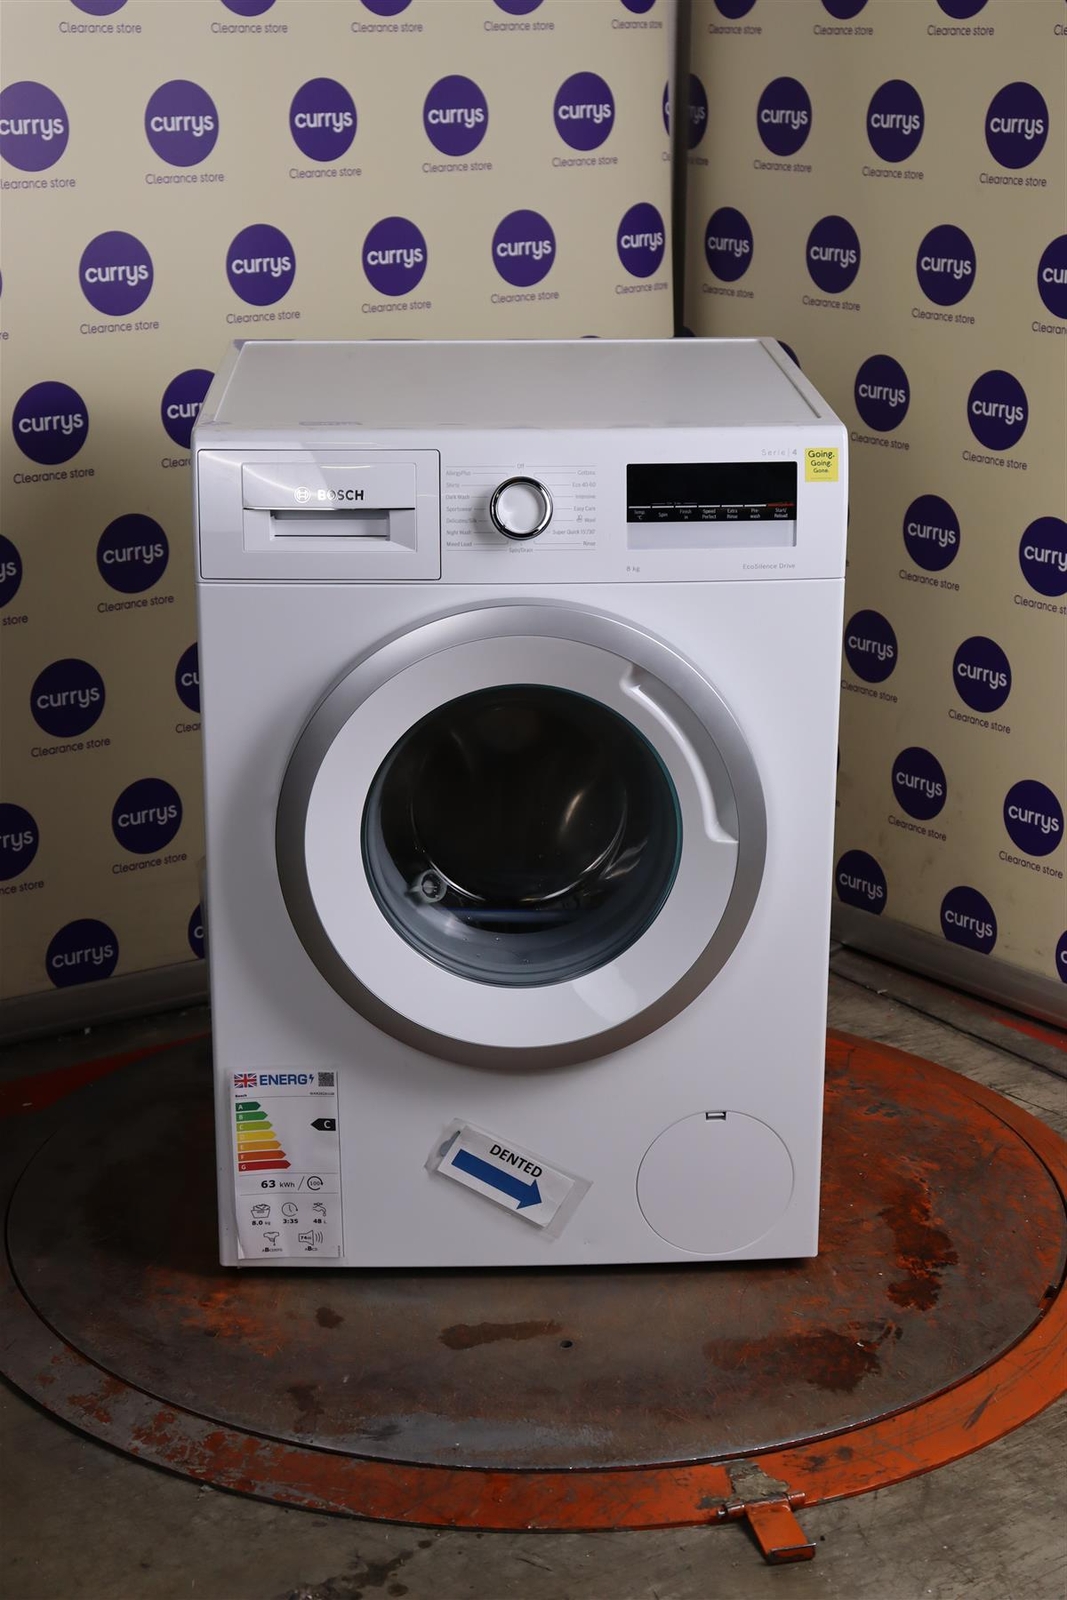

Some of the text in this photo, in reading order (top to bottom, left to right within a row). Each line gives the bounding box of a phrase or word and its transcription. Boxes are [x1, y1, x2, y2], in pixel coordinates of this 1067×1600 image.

[59, 22, 141, 33] Clearance store
[211, 22, 288, 33] Clearance store
[351, 22, 423, 33] Clearance store
[484, 21, 554, 31] Clearance store
[612, 19, 648, 29] Clearance
[708, 24, 762, 35] Clearance store
[814, 25, 873, 35] Clearance store
[927, 25, 994, 35] Clearance store
[295, 112, 353, 132] currys
[428, 108, 484, 128] currys
[558, 104, 611, 123] currys
[761, 109, 808, 129] currys
[0, 119, 64, 140] currys
[151, 116, 214, 137] currys
[871, 114, 920, 135] currys
[990, 118, 1043, 140] currys
[422, 163, 492, 173] Clearance store
[552, 157, 618, 167] Clearance store
[754, 160, 812, 173] Clearance store
[145, 174, 224, 184] Clearance store
[289, 168, 362, 179] Clearance store
[862, 166, 924, 180] Clearance store
[979, 173, 1047, 187] Clearance store
[0, 178, 76, 190] learance store
[497, 240, 551, 260] currys
[621, 233, 665, 252] currys
[708, 237, 749, 257] currys
[367, 248, 423, 268] currys
[810, 246, 856, 268] currys
[85, 265, 148, 286] currys
[232, 257, 291, 277] currys
[921, 257, 971, 279] currys
[491, 292, 559, 304] Clearance store
[615, 284, 652, 295] Clearance
[702, 284, 754, 299] Clearance store
[362, 301, 431, 313] Clearance store
[802, 296, 861, 312] Clearance store
[226, 311, 300, 324] Clearance store
[911, 308, 976, 325] Clearance store
[80, 322, 159, 334] Clearance store
[1032, 321, 1067, 335] Clearan
[859, 384, 905, 407] currys
[167, 403, 201, 421] cur
[972, 401, 1023, 425] currys
[19, 414, 83, 434] currys
[850, 432, 910, 451] Clearance store
[761, 448, 786, 456] Serie
[808, 450, 835, 459] Going.
[962, 450, 1028, 471] Clearance store
[161, 457, 191, 469] Clear
[13, 467, 95, 484] Clearance store
[317, 489, 364, 501] BOSCH
[908, 523, 956, 547] currys
[103, 544, 163, 564] currys
[1024, 546, 1067, 571] curry
[899, 570, 960, 592] Clearance store
[97, 594, 175, 614] Clearance store
[1014, 594, 1057, 613] Clearance
[2, 614, 28, 627] store
[848, 636, 893, 660] currys
[957, 664, 1007, 690] currys
[37, 688, 100, 708] currys
[841, 680, 898, 703] Clearance store
[175, 723, 201, 734] Clear
[948, 709, 1011, 734] Clearance store
[31, 736, 111, 758] Clearance store
[896, 771, 943, 798] currys
[118, 805, 177, 827] currys
[1008, 805, 1060, 834] currys
[888, 815, 947, 842] Clearance store
[112, 852, 187, 875] Clearance store
[999, 850, 1063, 879] Clearance store
[19, 880, 45, 893] store
[839, 872, 884, 900] currys
[945, 909, 993, 938] currys
[52, 945, 113, 967] currys
[260, 1074, 307, 1086] ENERG
[323, 1120, 331, 1129] C
[489, 1144, 543, 1178] DENTED
[261, 1180, 276, 1189] 63
